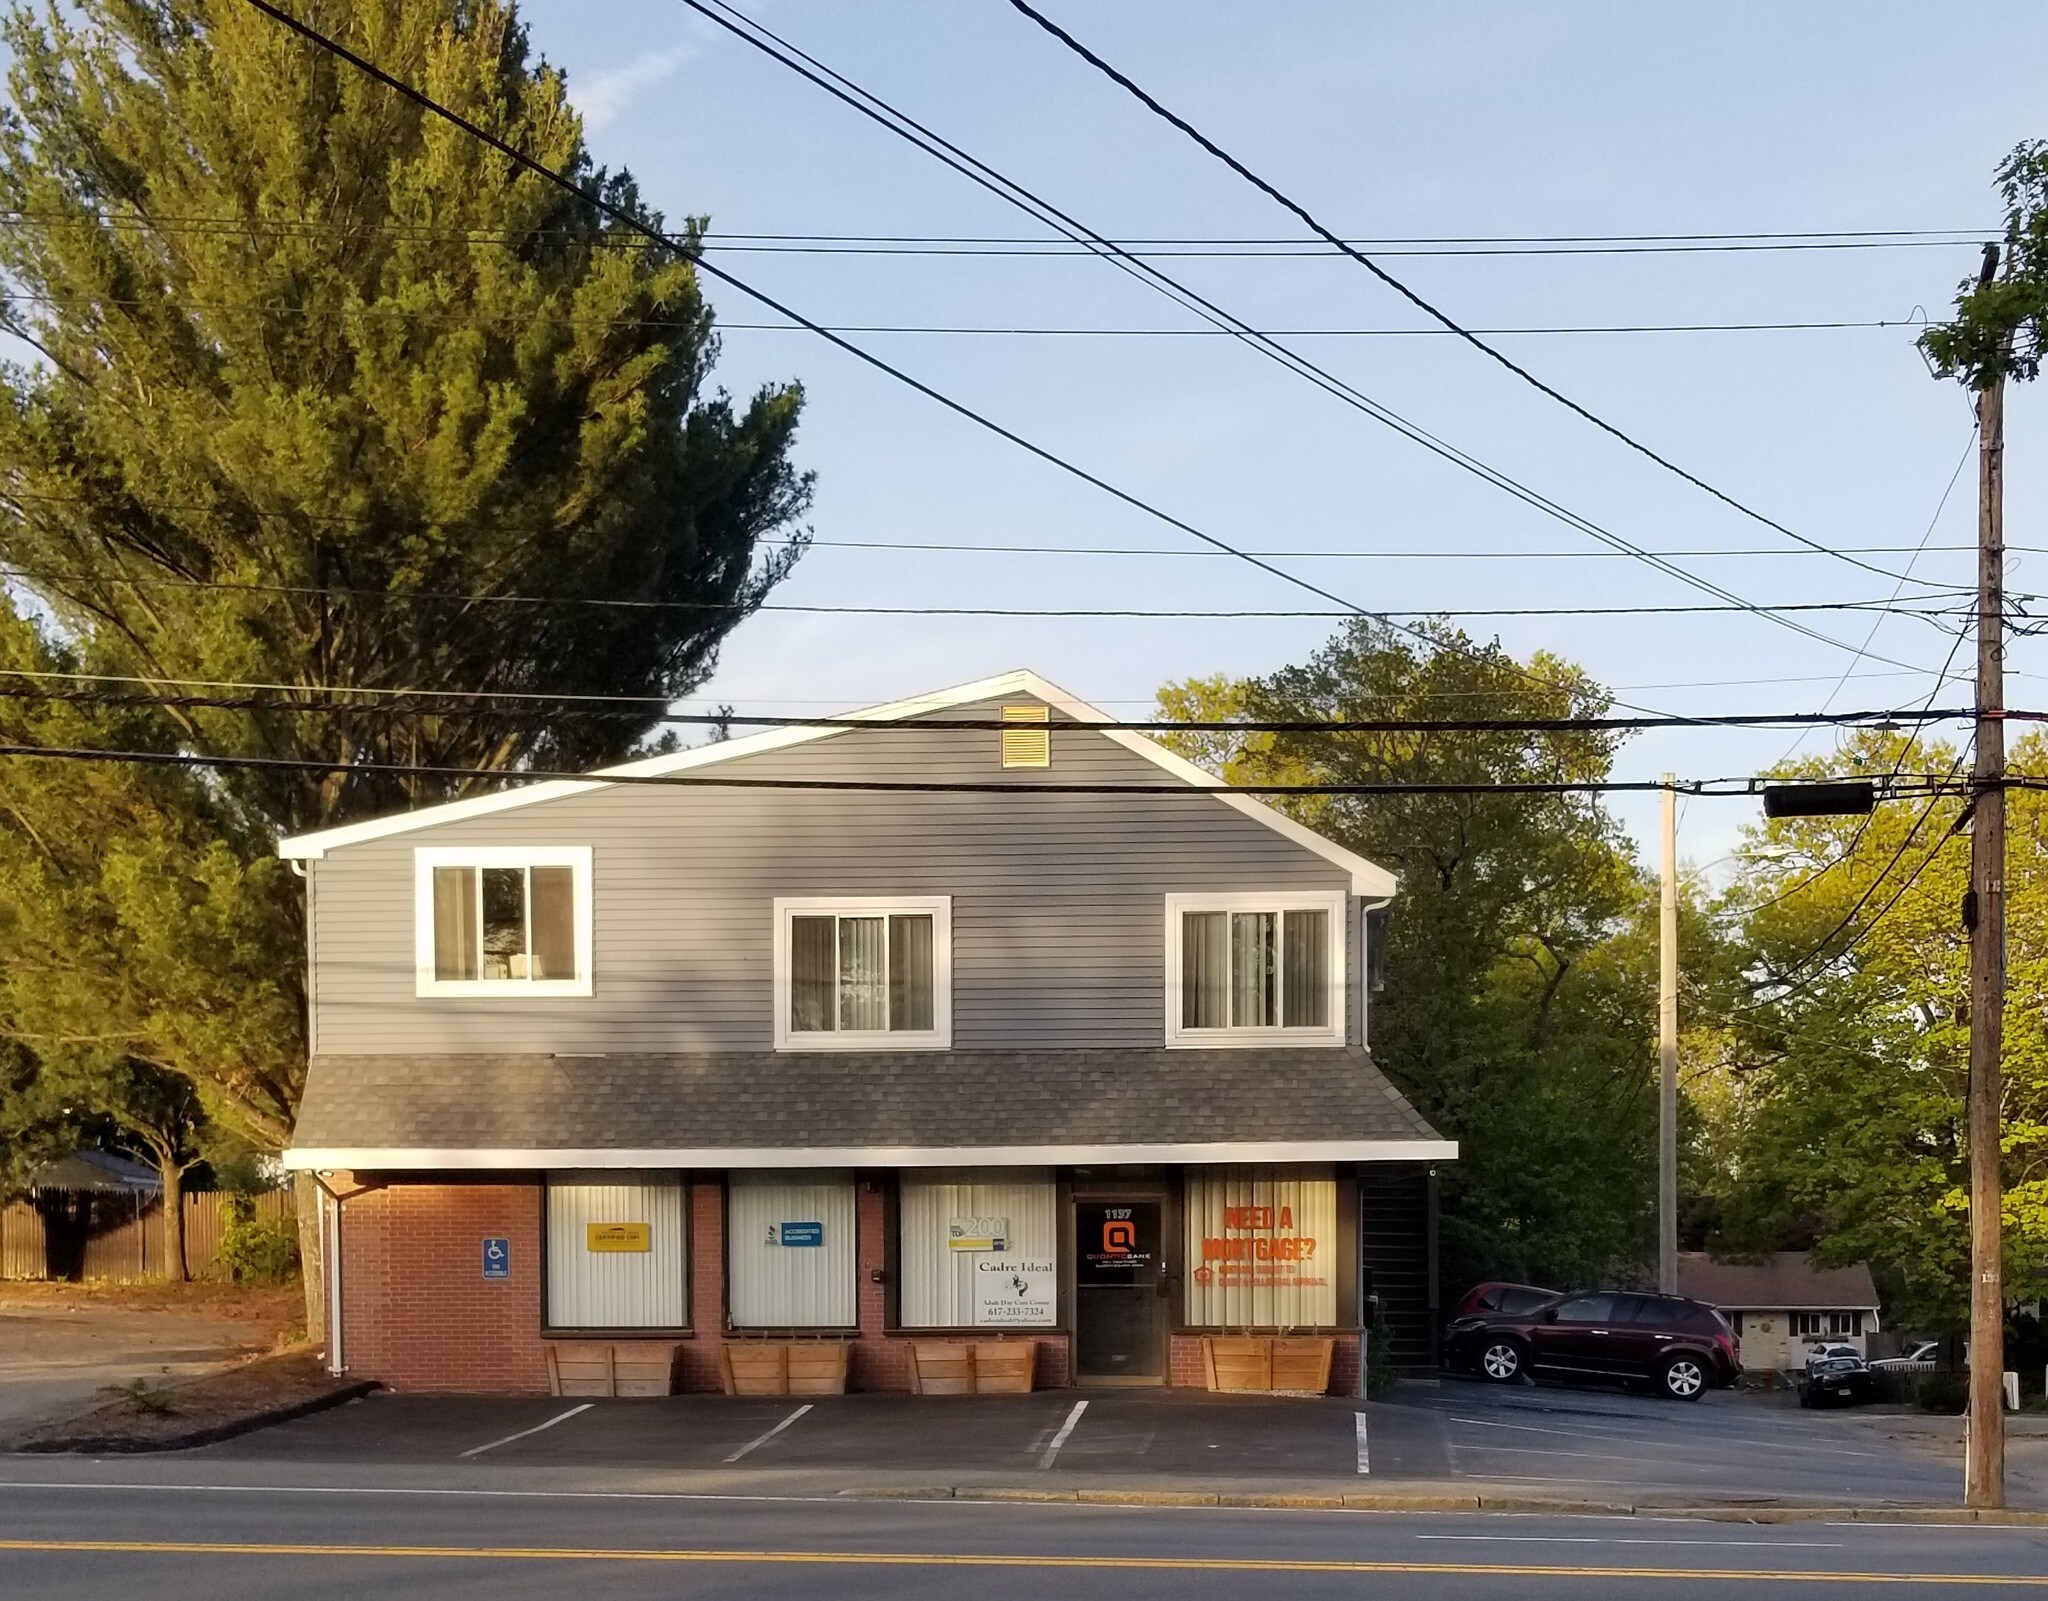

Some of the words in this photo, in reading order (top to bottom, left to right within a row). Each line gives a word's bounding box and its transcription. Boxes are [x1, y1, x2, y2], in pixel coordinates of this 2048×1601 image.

[1105, 1209, 1132, 1219] 1137
[1225, 1206, 1275, 1229] NEED
[1279, 1206, 1293, 1229] A
[965, 1217, 1006, 1237] 200
[1202, 1237, 1317, 1261] MORTGAGE?
[979, 1261, 1018, 1272] Cadre
[1021, 1261, 1053, 1272] Ideal
[988, 1307, 1044, 1316] 617-233-7324
